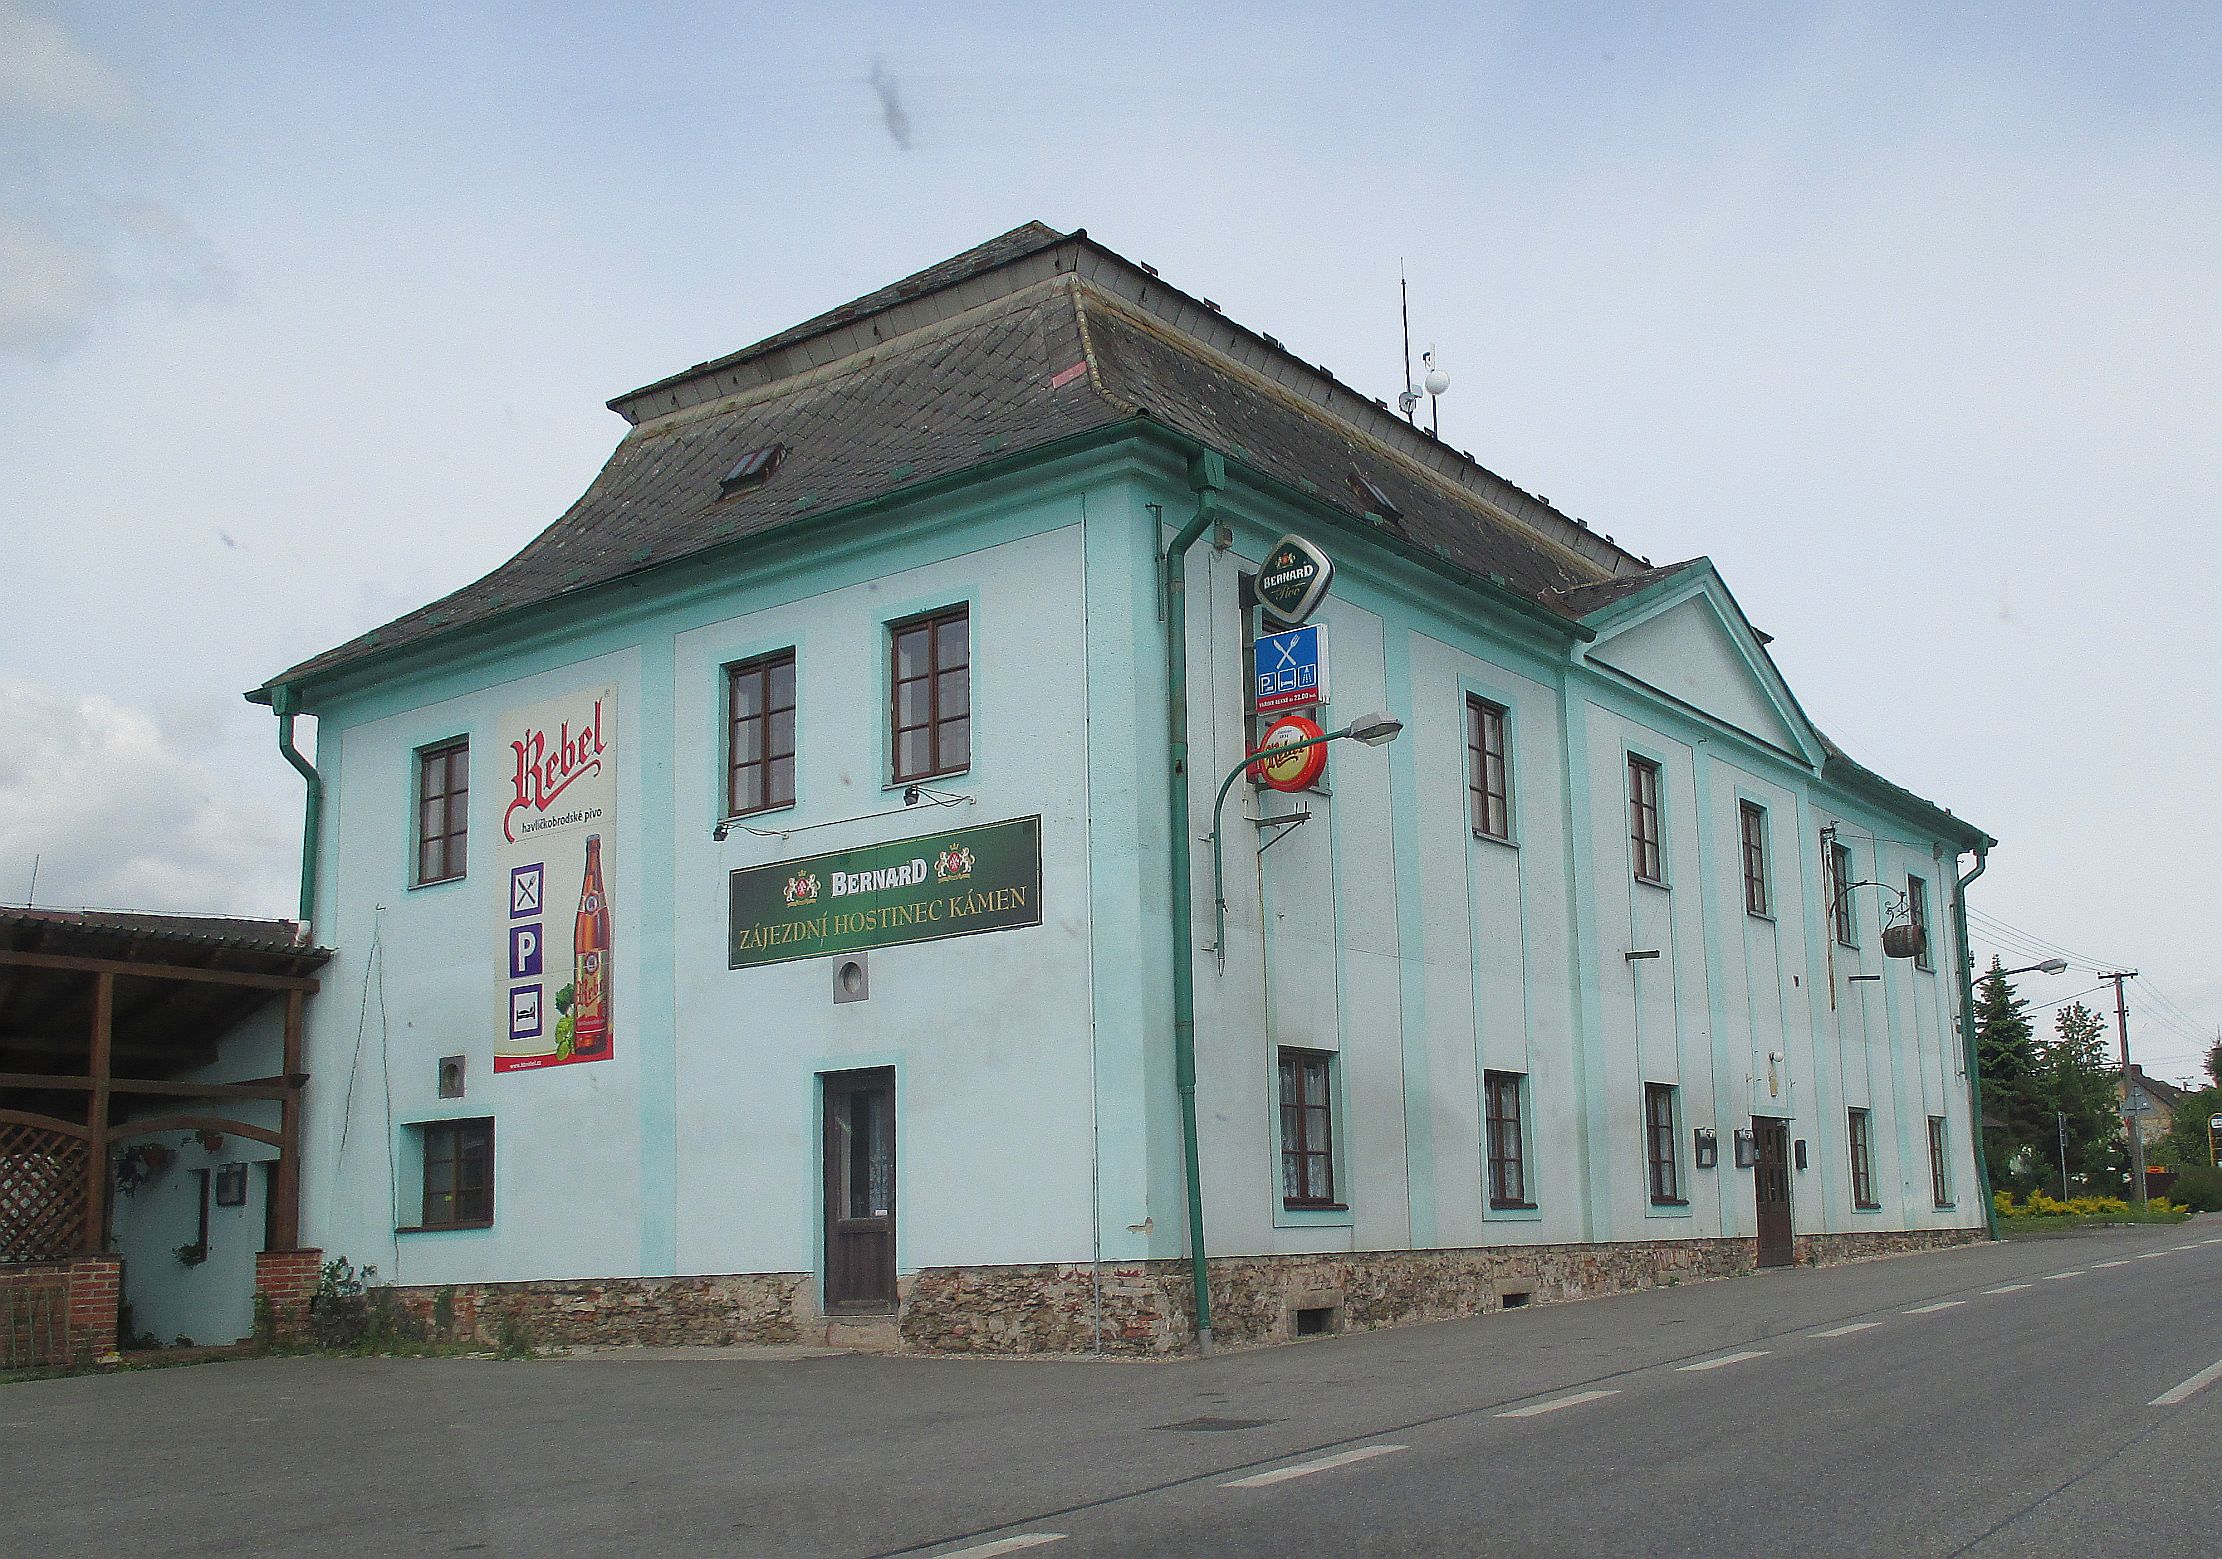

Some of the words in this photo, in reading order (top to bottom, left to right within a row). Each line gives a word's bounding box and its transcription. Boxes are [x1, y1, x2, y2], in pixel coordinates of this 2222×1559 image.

[1263, 564, 1314, 590] BERNARD
[1294, 692, 1309, 701] 22.00
[504, 697, 608, 844] Rebel
[584, 808, 602, 823] pivo
[831, 857, 928, 898] BERNARD
[740, 910, 828, 951] ZÁJEZDNÍ
[833, 899, 943, 936] HOSTINEC
[949, 886, 1028, 918] KÁMEN
[518, 931, 537, 972] P
